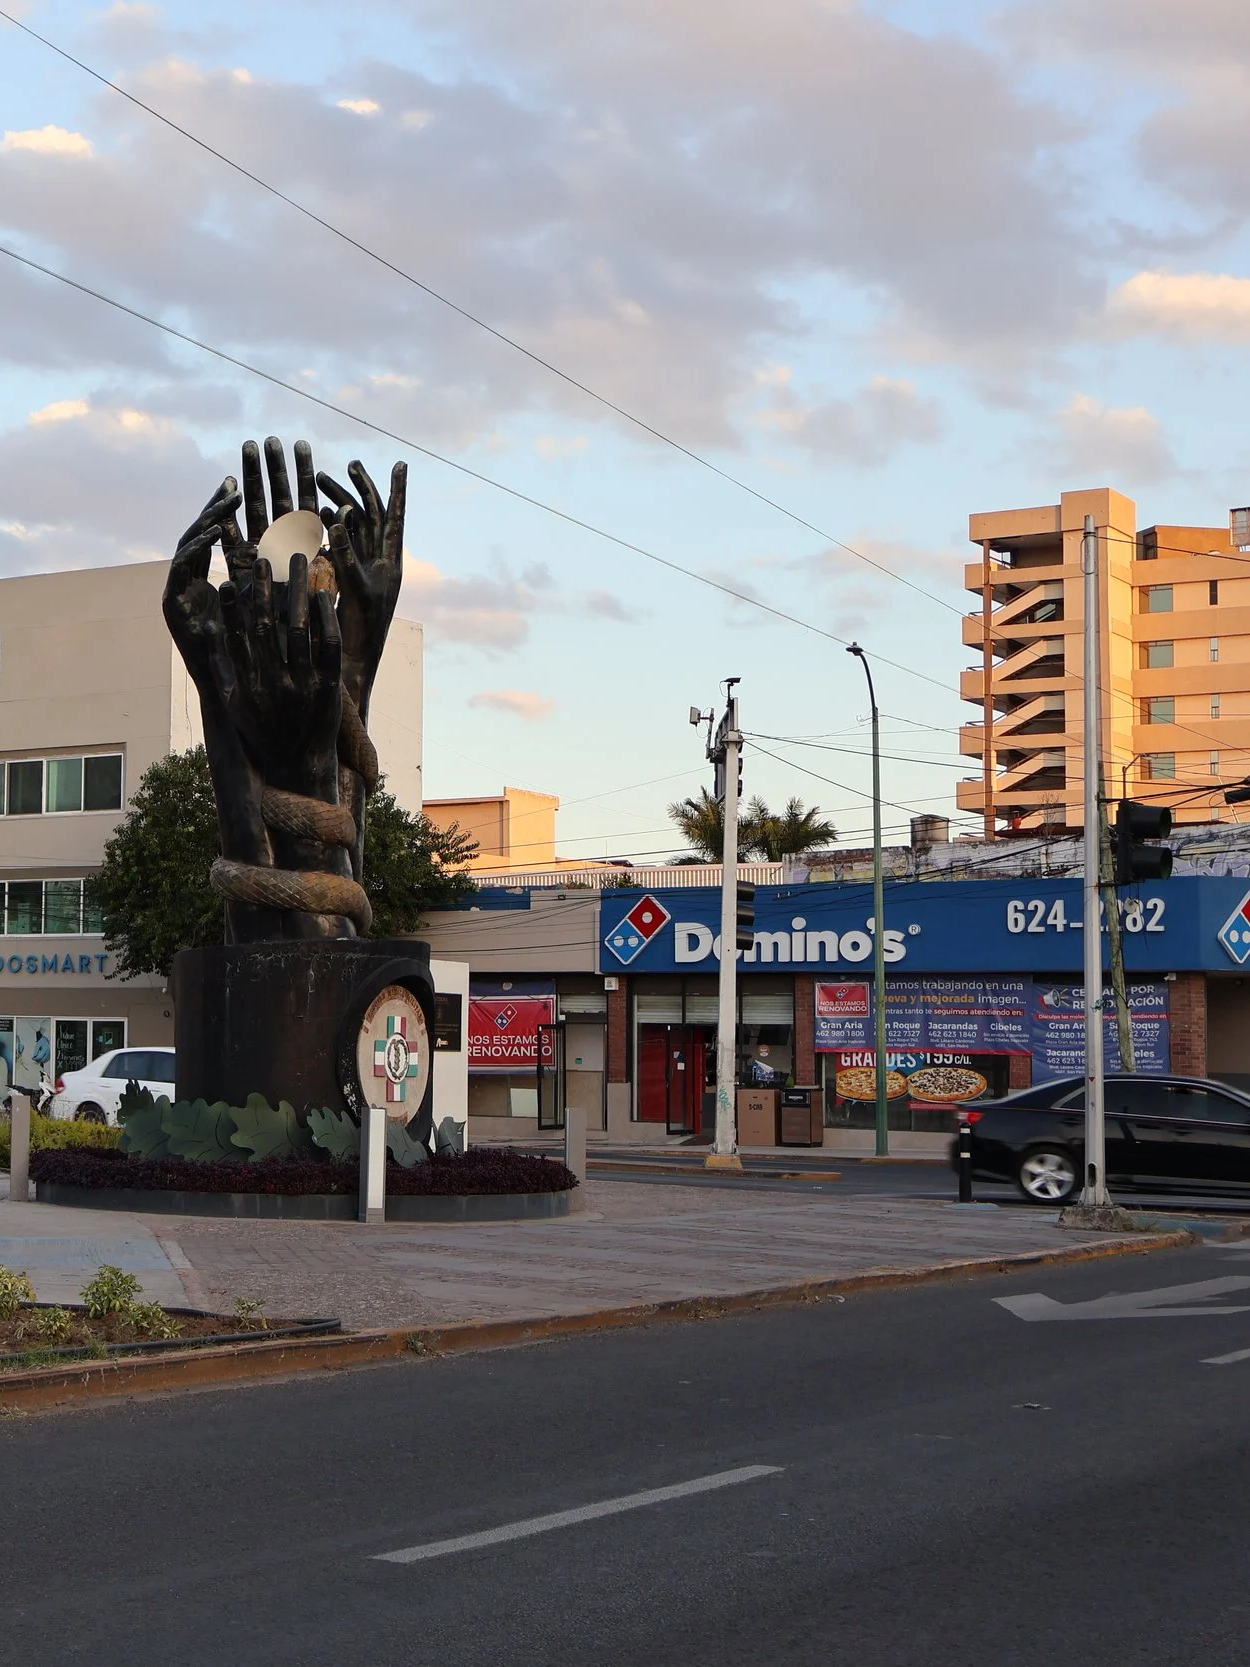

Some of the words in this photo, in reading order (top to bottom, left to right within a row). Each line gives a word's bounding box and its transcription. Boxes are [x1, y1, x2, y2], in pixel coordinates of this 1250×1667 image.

[922, 980, 984, 991] trabajando
[986, 982, 1000, 990] en
[1002, 982, 1024, 990] una
[1130, 985, 1156, 995] POR
[910, 994, 917, 1004] y
[919, 993, 975, 1005] mejorada
[934, 1008, 968, 1017] seguimos
[969, 1008, 1010, 1016] atendiendo
[820, 1021, 842, 1029] Gran
[844, 1021, 863, 1029] Aria
[893, 1021, 921, 1030] Roque
[928, 1022, 979, 1031] Jacarandas
[990, 1023, 1022, 1031] Cibeles
[1048, 1022, 1071, 1030] Gran
[1072, 1022, 1086, 1030] Ari
